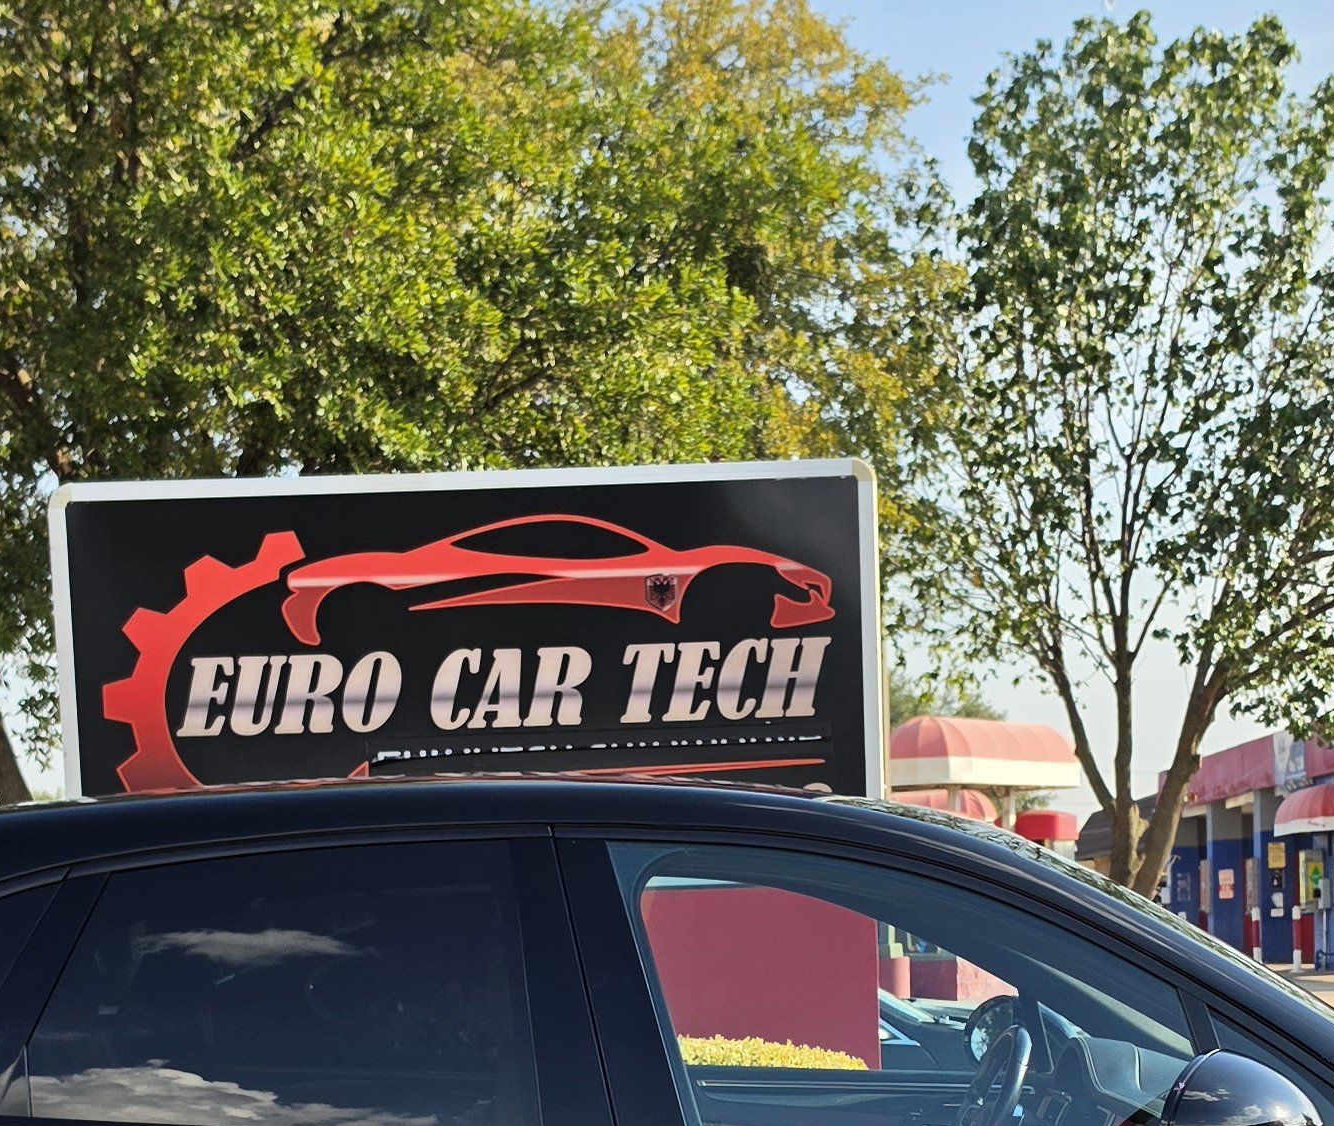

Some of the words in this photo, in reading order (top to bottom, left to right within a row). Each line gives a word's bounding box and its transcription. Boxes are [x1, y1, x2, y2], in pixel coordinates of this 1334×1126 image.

[176, 651, 403, 738] EURO
[429, 646, 593, 731] CAR
[620, 637, 832, 725] TECH
